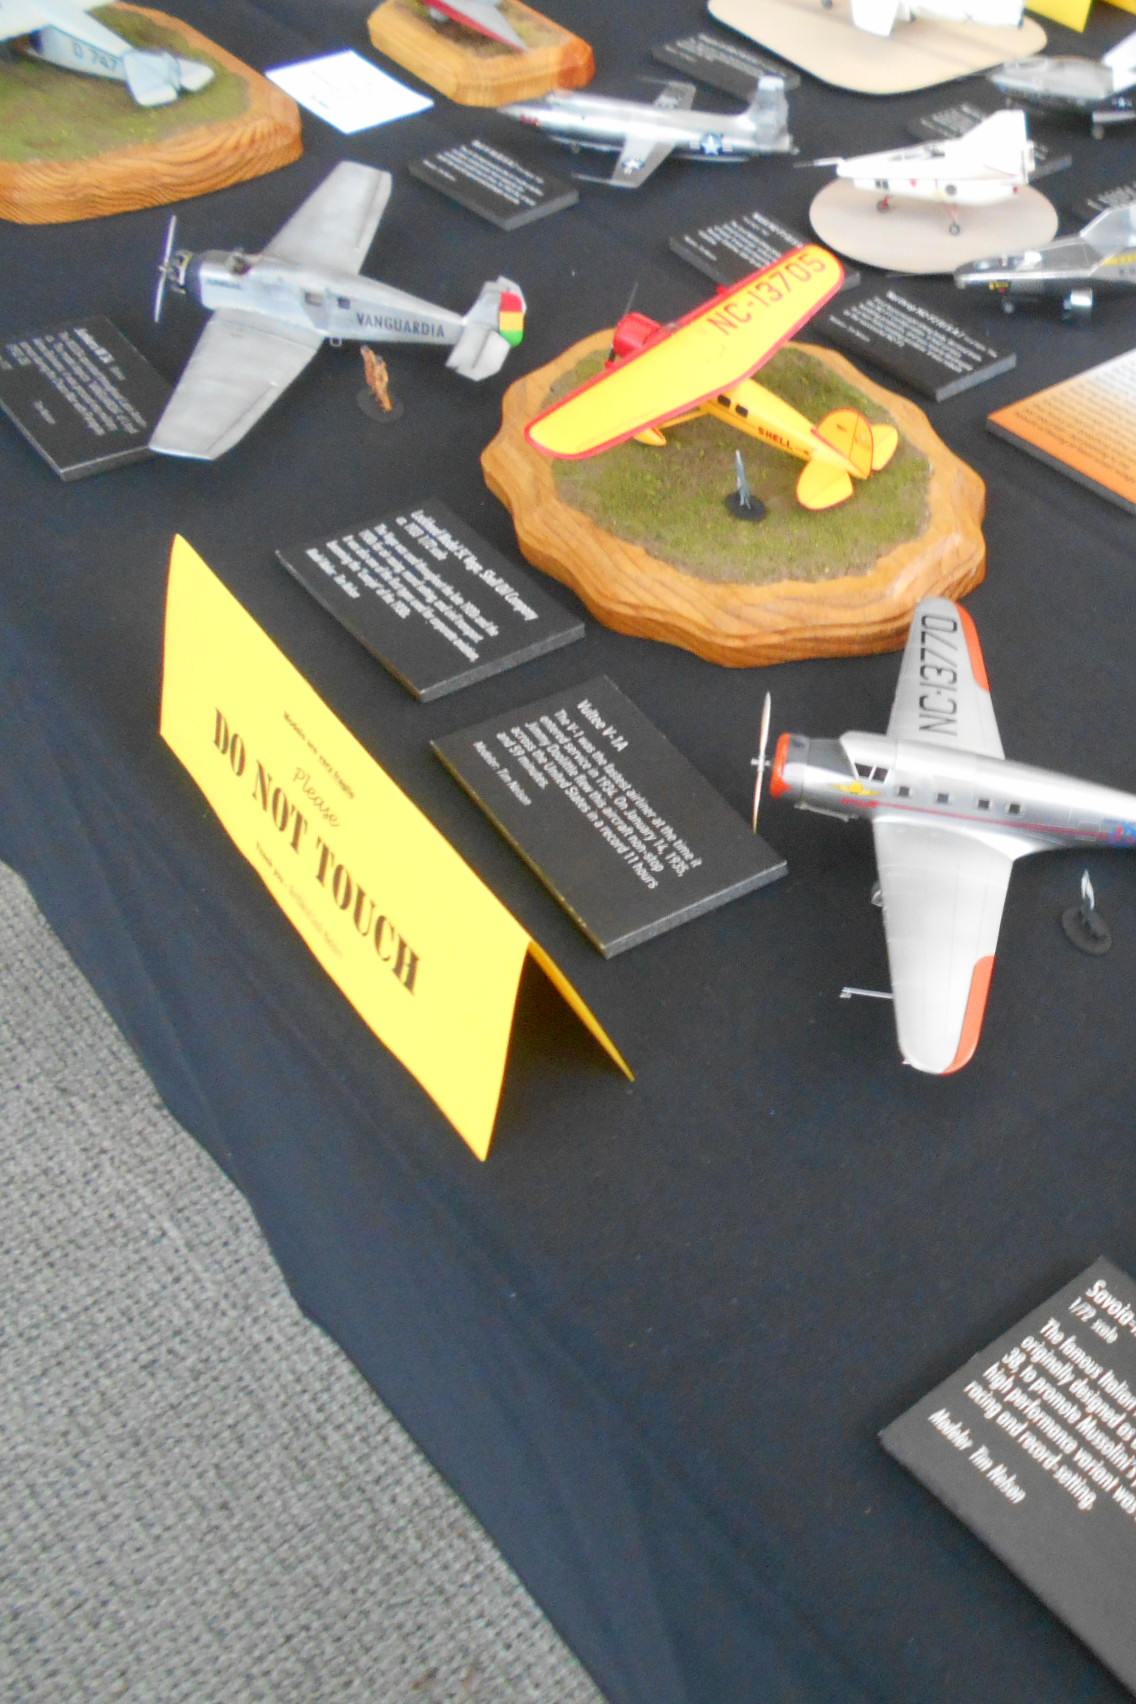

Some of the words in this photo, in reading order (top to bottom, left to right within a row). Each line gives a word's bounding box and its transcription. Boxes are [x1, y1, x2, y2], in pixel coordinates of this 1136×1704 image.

[705, 250, 827, 338] NC-13705
[356, 311, 446, 339] VANGUARDIA
[757, 426, 793, 451] SHELL
[497, 733, 517, 748] and
[509, 745, 525, 756] 59
[578, 700, 606, 730] Vultee
[603, 726, 629, 752] V-1A
[292, 766, 340, 828] Please
[511, 727, 537, 752] across
[532, 750, 548, 764] the
[544, 762, 573, 789] United
[565, 786, 591, 813] States
[587, 812, 599, 822] in
[600, 826, 630, 854] record
[624, 852, 639, 864] 11
[633, 862, 659, 889] hours
[555, 710, 571, 726] The
[567, 723, 585, 738] V-1
[592, 751, 607, 766] the
[626, 790, 657, 818] airliner
[652, 818, 666, 829] at
[660, 826, 677, 842] the
[673, 840, 694, 861] time
[690, 859, 702, 868] it
[564, 743, 592, 770] service
[588, 768, 599, 778] in
[614, 796, 629, 811] On
[624, 810, 657, 841] January
[212, 706, 247, 778] DO
[251, 758, 309, 855] NOT
[315, 835, 420, 996] TOUCH
[589, 791, 607, 809] this
[602, 808, 634, 837] aircraft
[628, 835, 664, 872] non-stop
[1040, 1318, 1065, 1345] The
[1059, 1336, 1103, 1379] famous
[1069, 1298, 1097, 1322] 1/72
[1092, 1320, 1118, 1344] scale
[1002, 1348, 1027, 1373] 38,
[1020, 1365, 1037, 1383] to
[1021, 1336, 1075, 1386] originally
[1070, 1378, 1127, 1429] designed
[1117, 1423, 1136, 1441] as
[964, 1381, 1003, 1419] racing
[996, 1412, 1029, 1437] and
[984, 1362, 1015, 1394] high
[1004, 1388, 1078, 1454] performance
[1074, 1448, 1119, 1492] variant
[1028, 1378, 1082, 1424] promote
[969, 1446, 993, 1472] Tim
[987, 1464, 1026, 1504] Nelson
